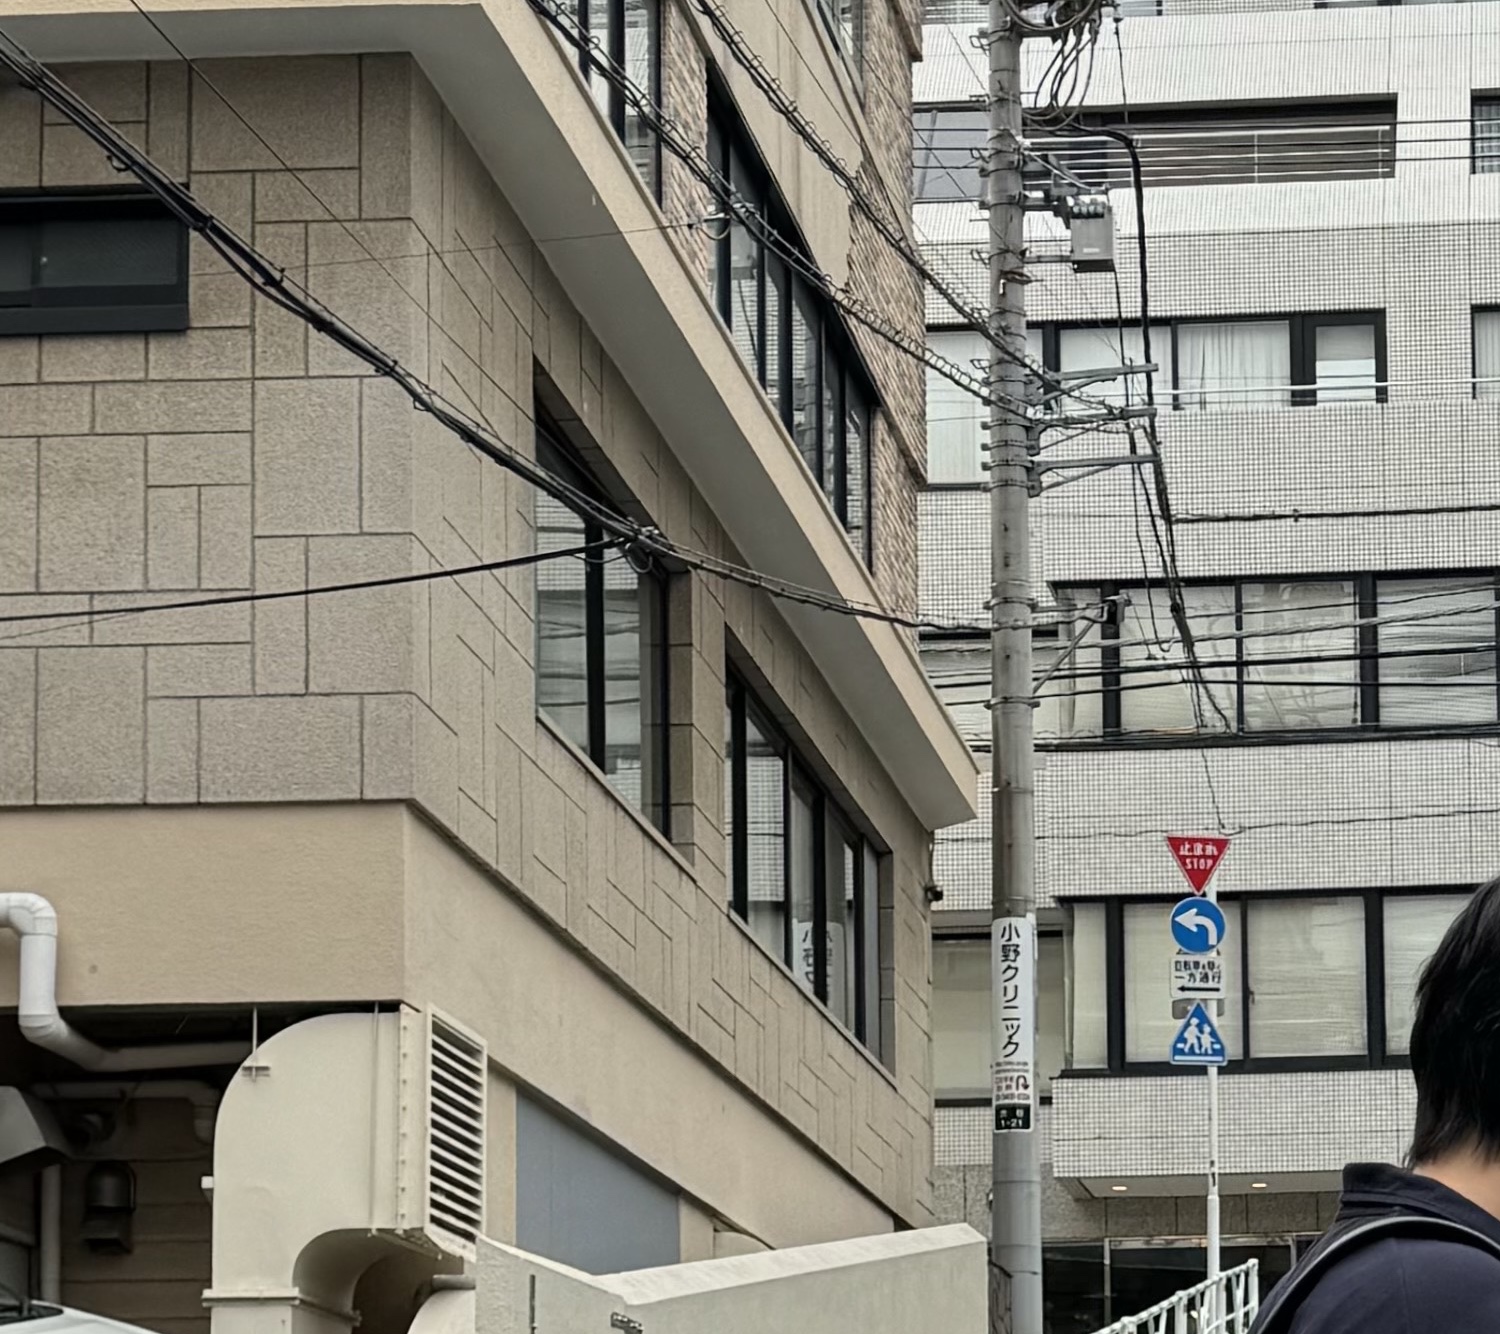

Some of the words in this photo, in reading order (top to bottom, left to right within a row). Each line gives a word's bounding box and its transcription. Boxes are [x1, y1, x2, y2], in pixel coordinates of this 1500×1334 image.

[1185, 858, 1214, 870] STOP
[1174, 971, 1221, 984] 一方通行
[1001, 922, 1021, 1058] 小野クリニック
